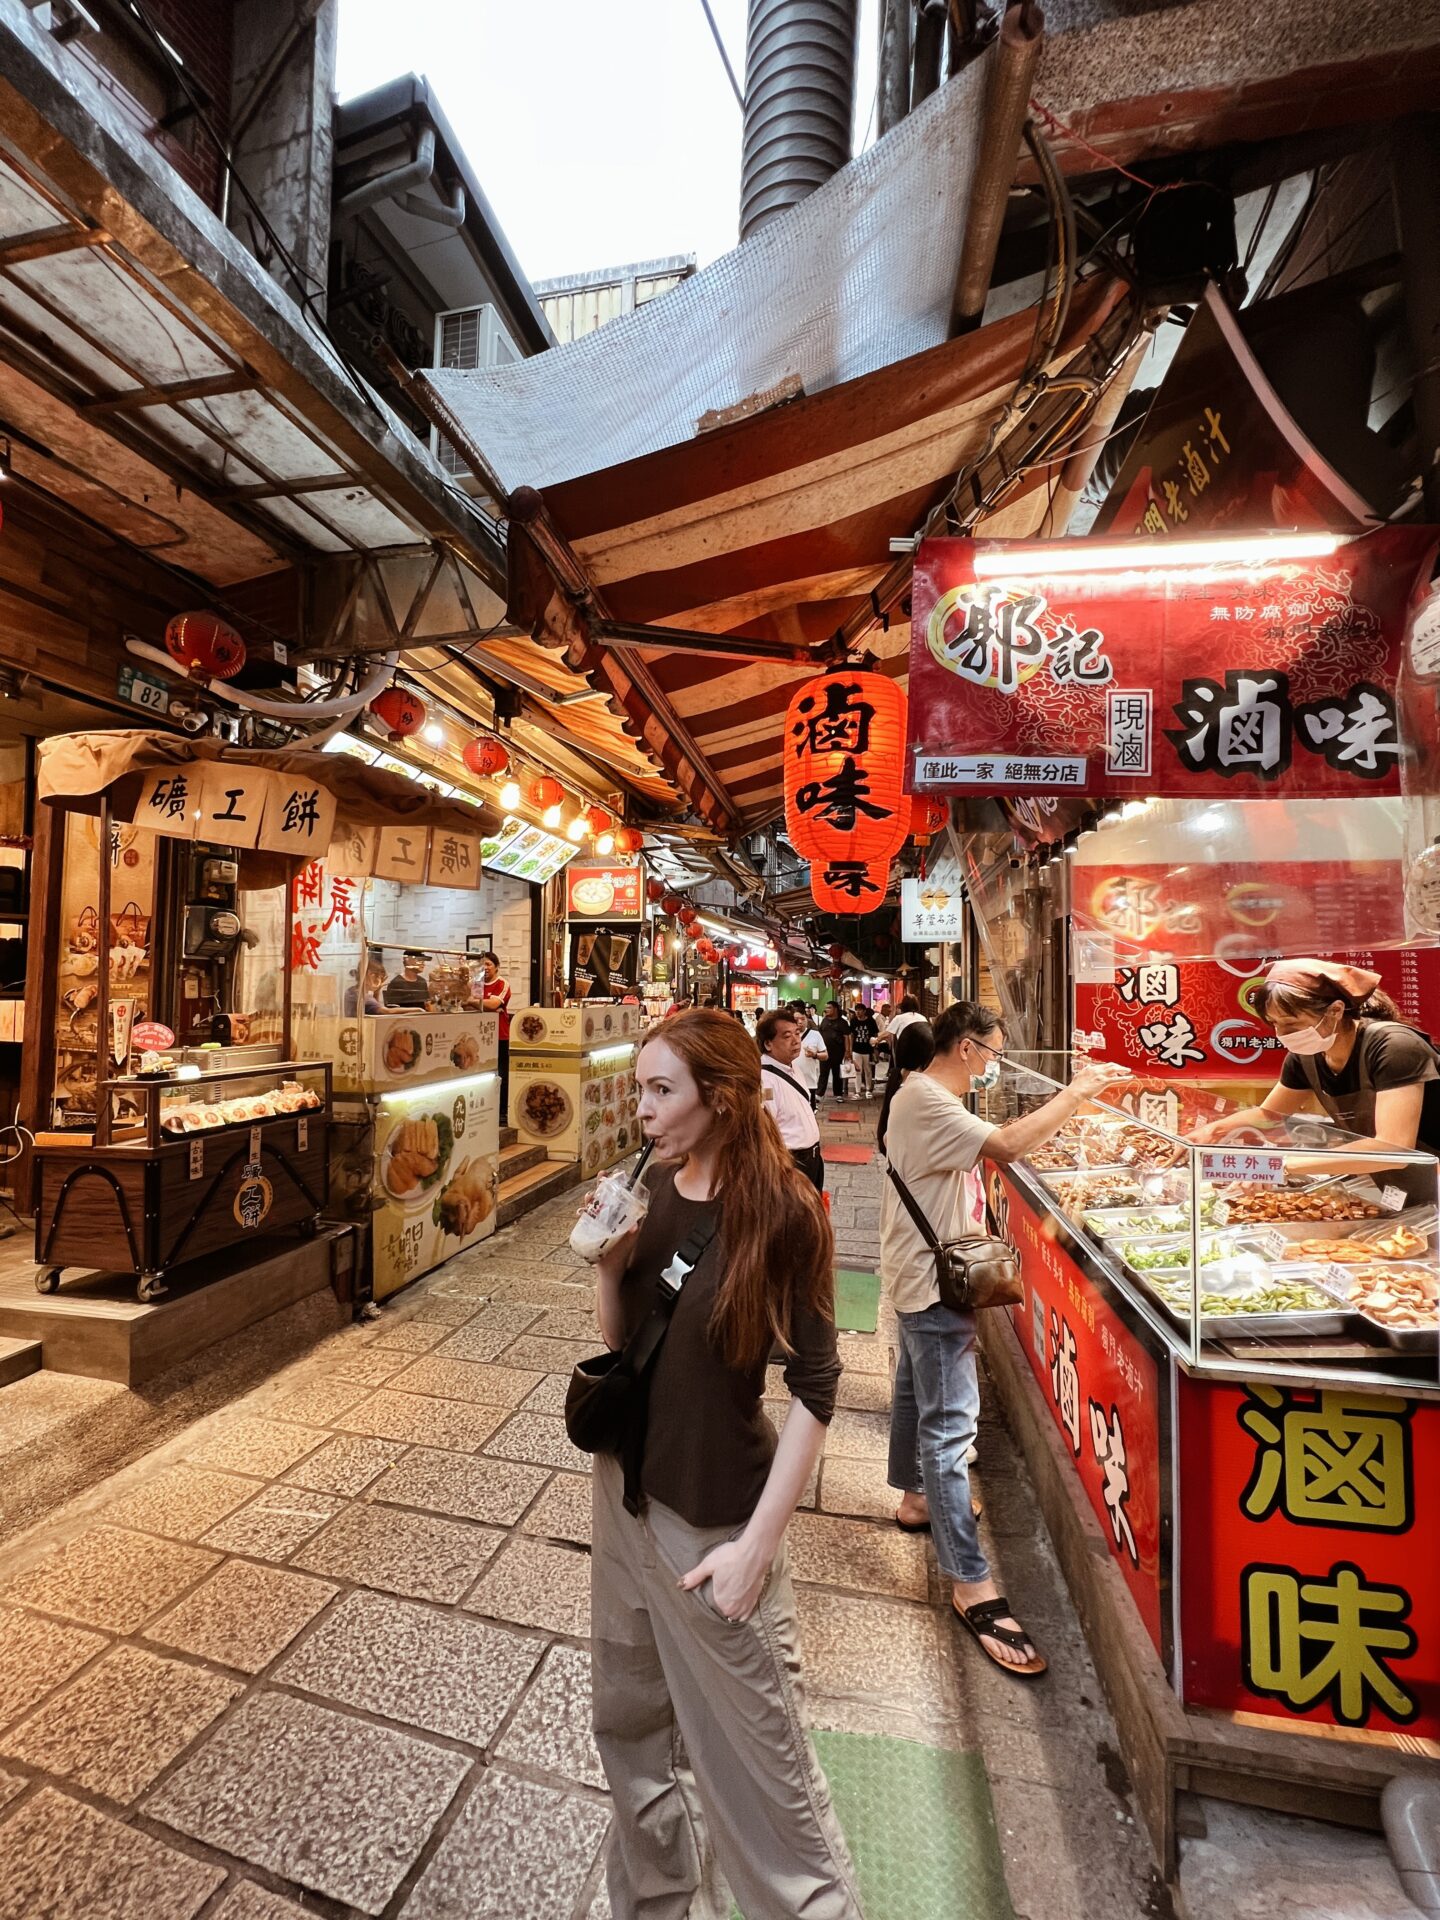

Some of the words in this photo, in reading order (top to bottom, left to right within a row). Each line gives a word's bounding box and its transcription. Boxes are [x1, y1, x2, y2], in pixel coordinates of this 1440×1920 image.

[946, 585, 1110, 688] 郭記
[1210, 602, 1310, 621] 無防腐劑
[140, 686, 162, 708] 82
[1186, 678, 1404, 772] 滷味
[481, 741, 495, 769] 九份
[792, 682, 893, 832] 滷味
[1113, 697, 1145, 769] 現滷
[923, 761, 994, 780] 僅此一家
[1004, 763, 1079, 782] 絕無分店
[148, 774, 323, 839] 礦工餅
[454, 1101, 465, 1132] 九份
[1202, 1154, 1283, 1171] 僅供外帶
[1205, 1171, 1248, 1180] TAKEOUT
[241, 1164, 263, 1229] 礦工餅
[1052, 1312, 1137, 1562] 滷味
[1241, 1382, 1415, 1722] 滷味
